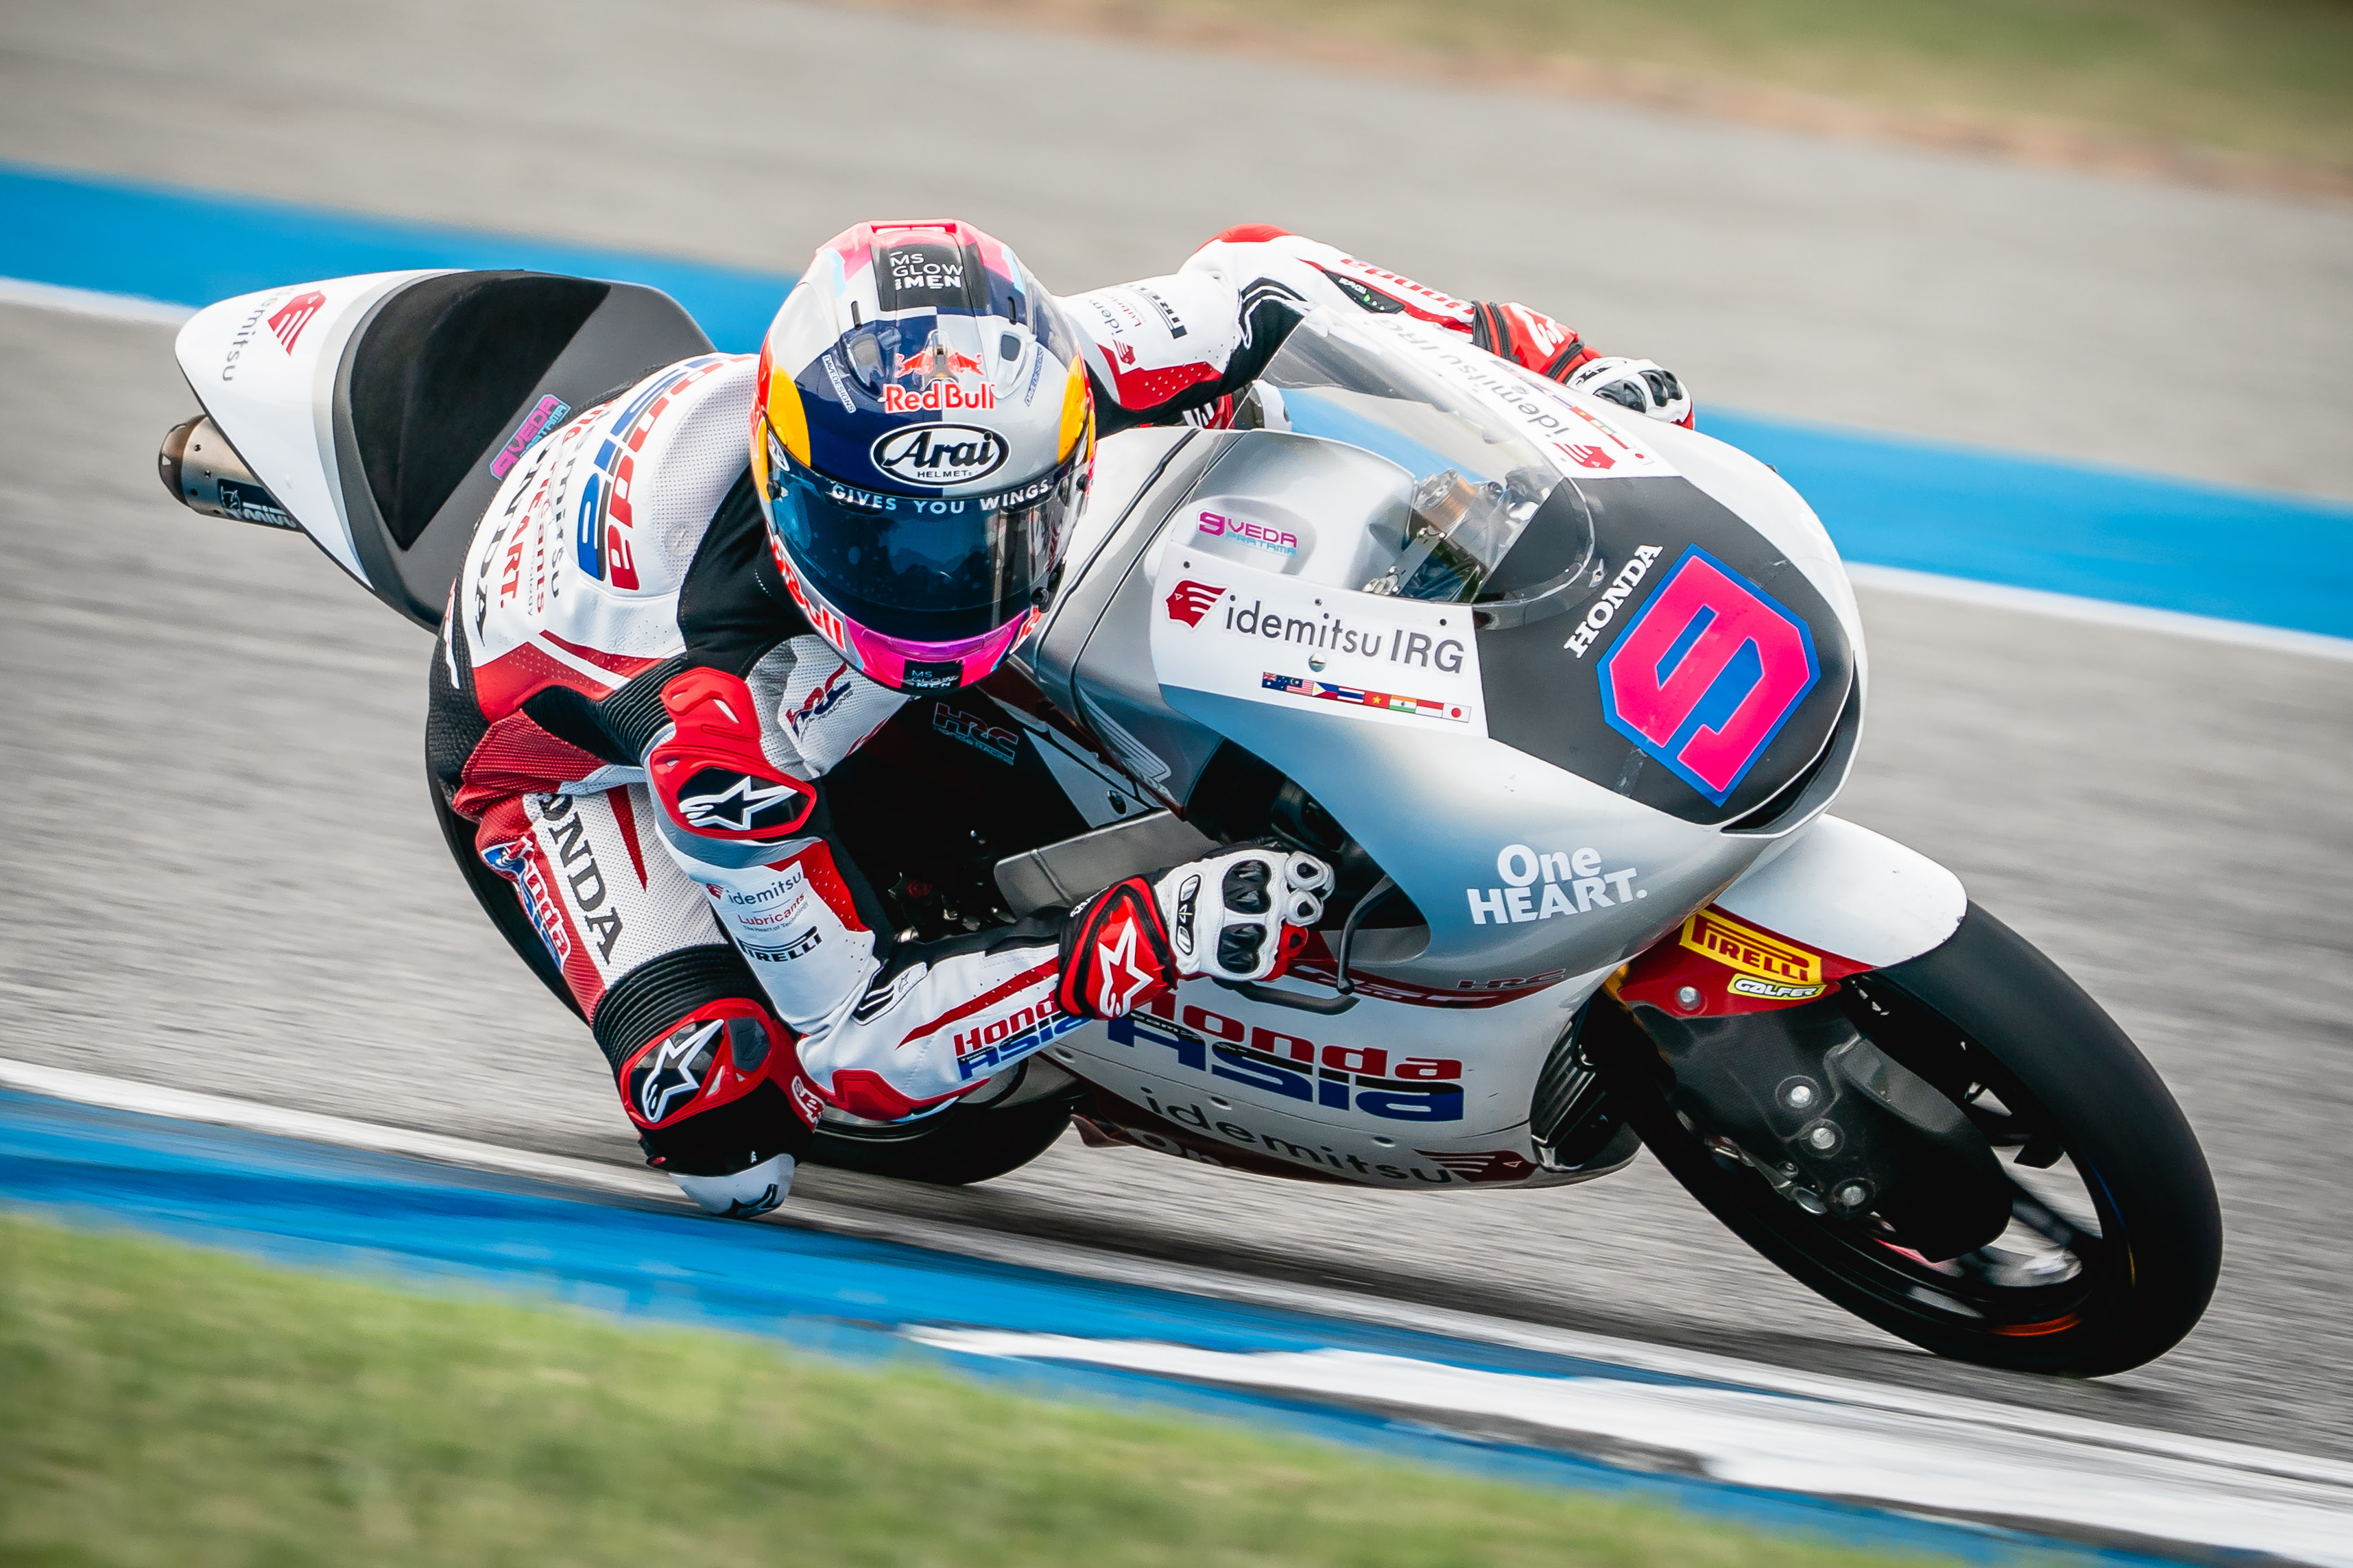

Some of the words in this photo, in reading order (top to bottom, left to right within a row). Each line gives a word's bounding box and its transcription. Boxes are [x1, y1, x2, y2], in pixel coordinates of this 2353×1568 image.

[890, 251, 924, 267] MS
[892, 263, 963, 277] GLOW
[904, 275, 961, 289] MEN
[824, 356, 855, 412] DAVEDESIGNS
[886, 382, 940, 411] Red
[945, 383, 996, 409] Bull
[1440, 354, 1569, 437] idemitsu
[881, 431, 995, 468] Arai
[832, 485, 897, 511] GIVES
[913, 500, 965, 514] YOU
[1199, 511, 1226, 536] 9
[1228, 518, 1298, 548] VEDA
[1226, 531, 1297, 557] PRATAMA
[1564, 544, 1663, 658] HONDA
[1226, 596, 1381, 657] idemitsu
[1390, 629, 1466, 673] IRG
[912, 670, 933, 678] MS
[1609, 555, 1811, 793] 9
[933, 702, 1018, 761] HRC
[537, 793, 623, 965] ONDA
[1497, 844, 1602, 886] One
[726, 871, 801, 905] idemitsu
[1466, 868, 1648, 926] HEART.
[738, 893, 804, 926] Lubricants
[1691, 913, 1810, 982] PIRELLI
[1734, 978, 1817, 997] GALFER
[1140, 1085, 1453, 1184] idemitsu
